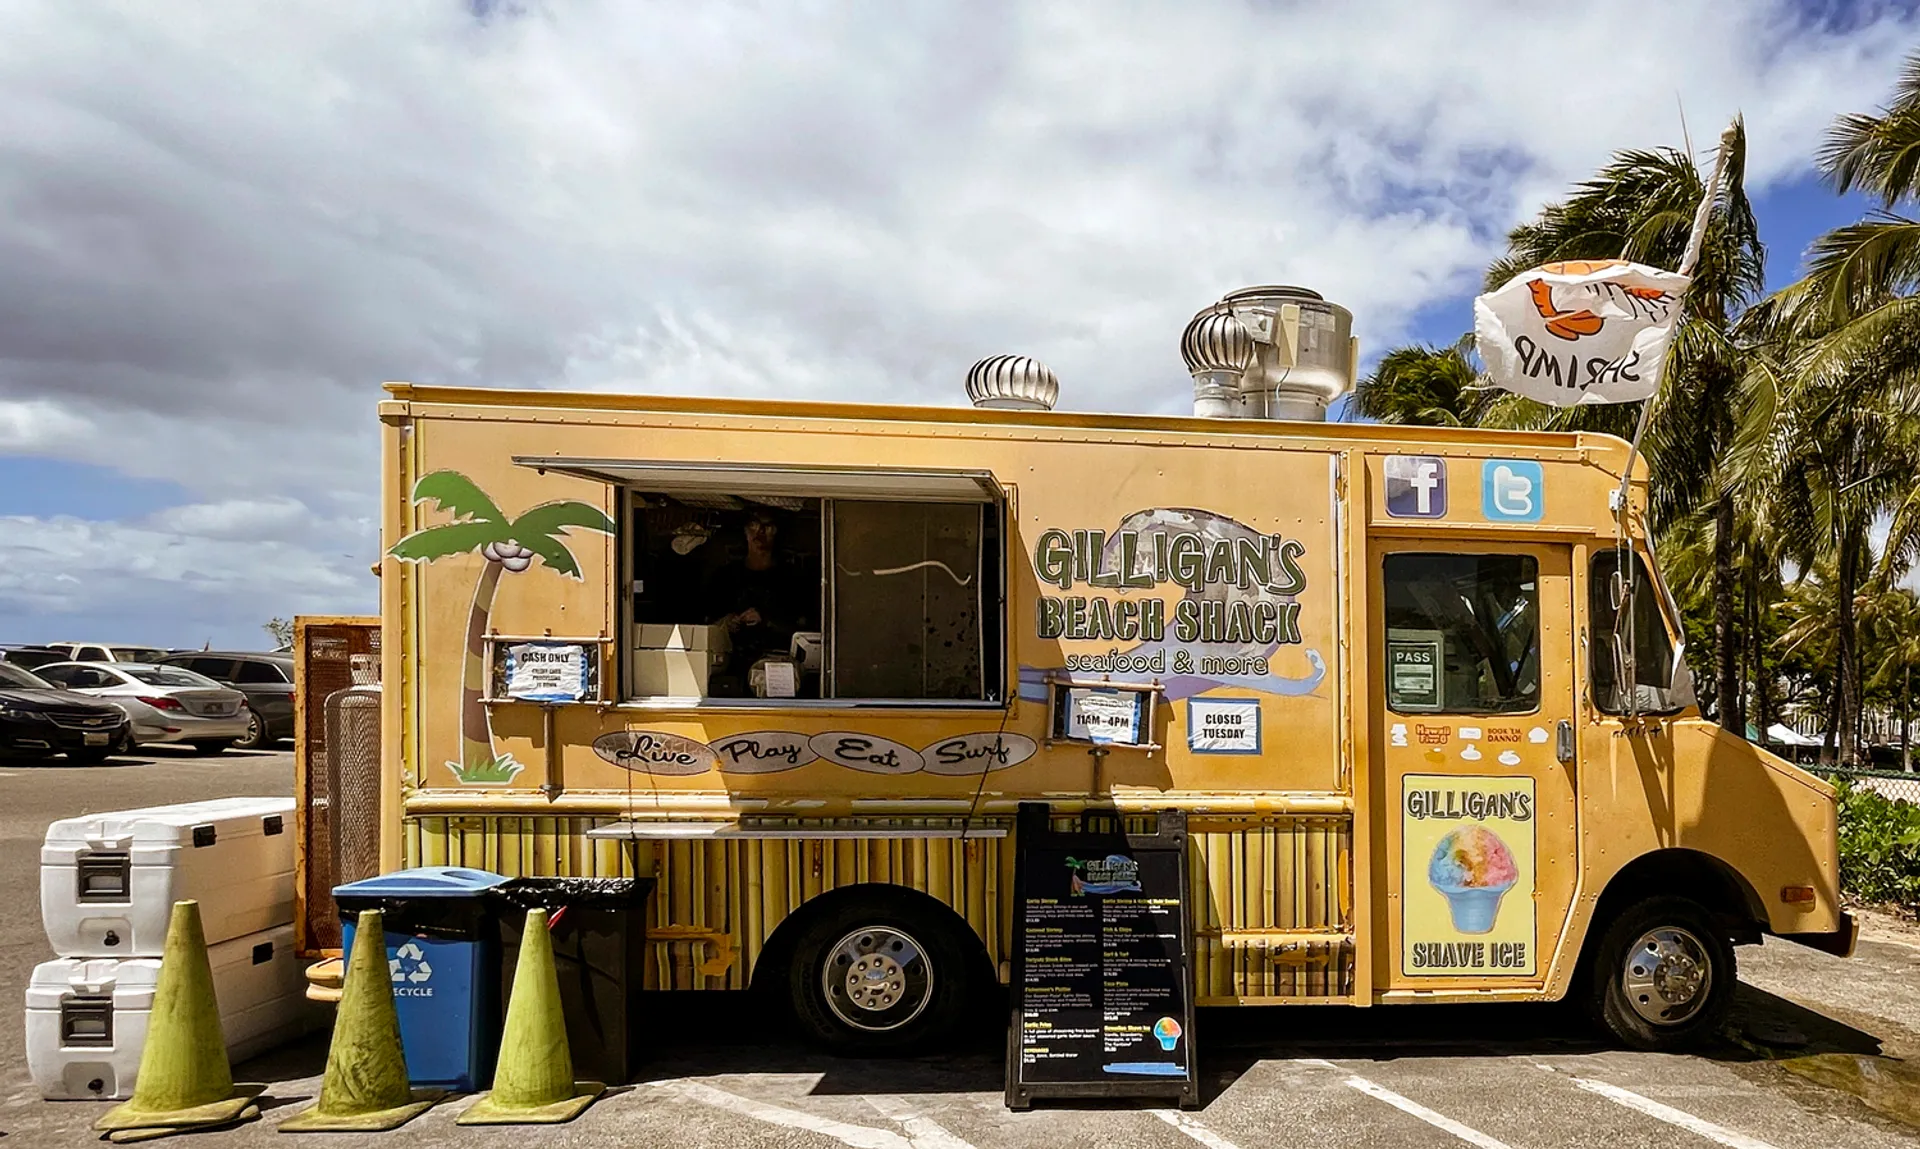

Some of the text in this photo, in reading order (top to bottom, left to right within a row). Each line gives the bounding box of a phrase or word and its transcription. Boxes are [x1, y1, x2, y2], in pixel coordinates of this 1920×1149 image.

[1035, 528, 1306, 596] GILLIGAN'S
[1037, 596, 1302, 644] BEACH SHACK
[521, 652, 570, 663] CASH ONLY
[1066, 648, 1269, 676] seafood & more
[1396, 651, 1431, 663] PASS
[1205, 714, 1242, 726] CLOSED
[1202, 728, 1245, 739] TUESDAY
[1487, 734, 1521, 743] DANNO!
[615, 735, 1010, 768] Live Play Eat Surf
[1407, 790, 1532, 822] GILLIGAN'S
[1412, 941, 1526, 968] SHAVE ICE
[393, 987, 433, 997] ECYCLE
